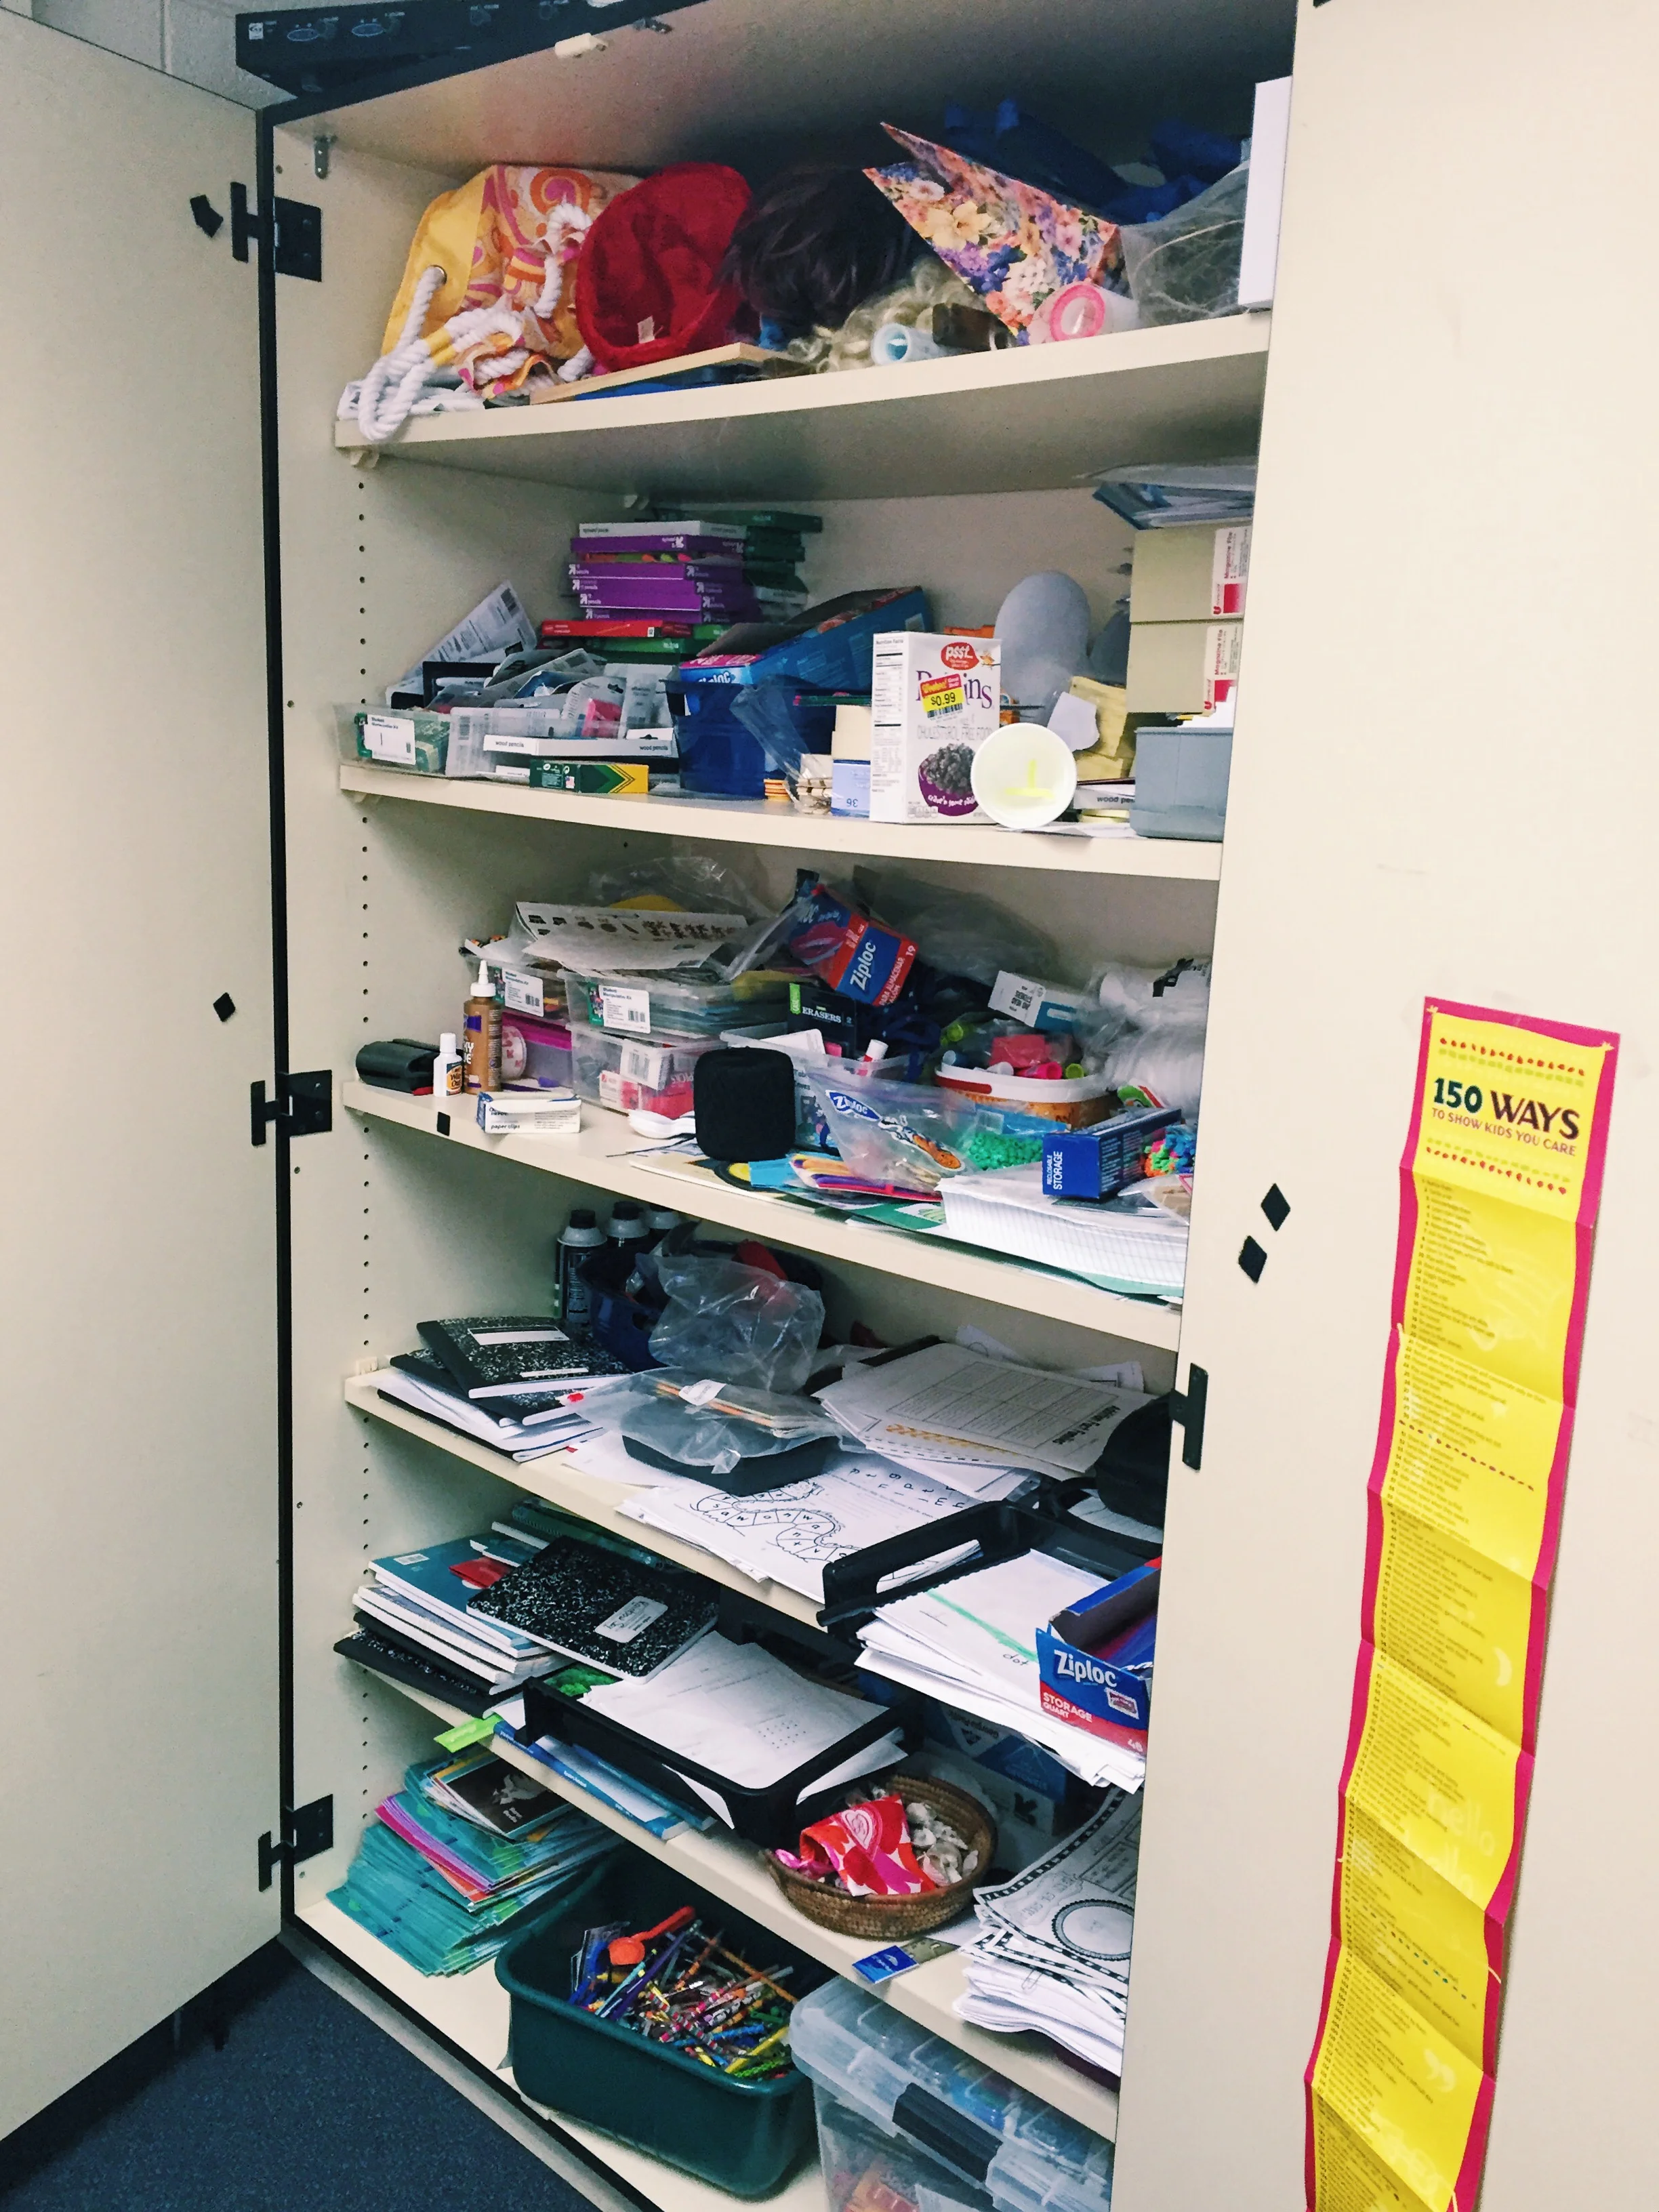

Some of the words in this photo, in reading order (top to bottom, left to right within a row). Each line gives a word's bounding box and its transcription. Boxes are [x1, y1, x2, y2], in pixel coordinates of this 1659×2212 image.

[931, 692, 956, 706] $0.99
[850, 941, 876, 991] Ziploc
[802, 1006, 842, 1023] ERASERS
[1433, 1078, 1483, 1113] 150
[1490, 1090, 1580, 1140] WAYS
[1431, 1107, 1446, 1120] TO
[1448, 1112, 1484, 1130] SHOW
[1485, 1122, 1513, 1139] KIDS
[1515, 1130, 1540, 1147] YOU
[1543, 1139, 1576, 1157] CARE
[1053, 1151, 1063, 1190] STORAGE
[1002, 1652, 1029, 1666] dot
[1054, 1649, 1118, 1687] Ziploc
[1042, 1692, 1093, 1723] STORAGE
[1042, 1702, 1070, 1719] QUART
